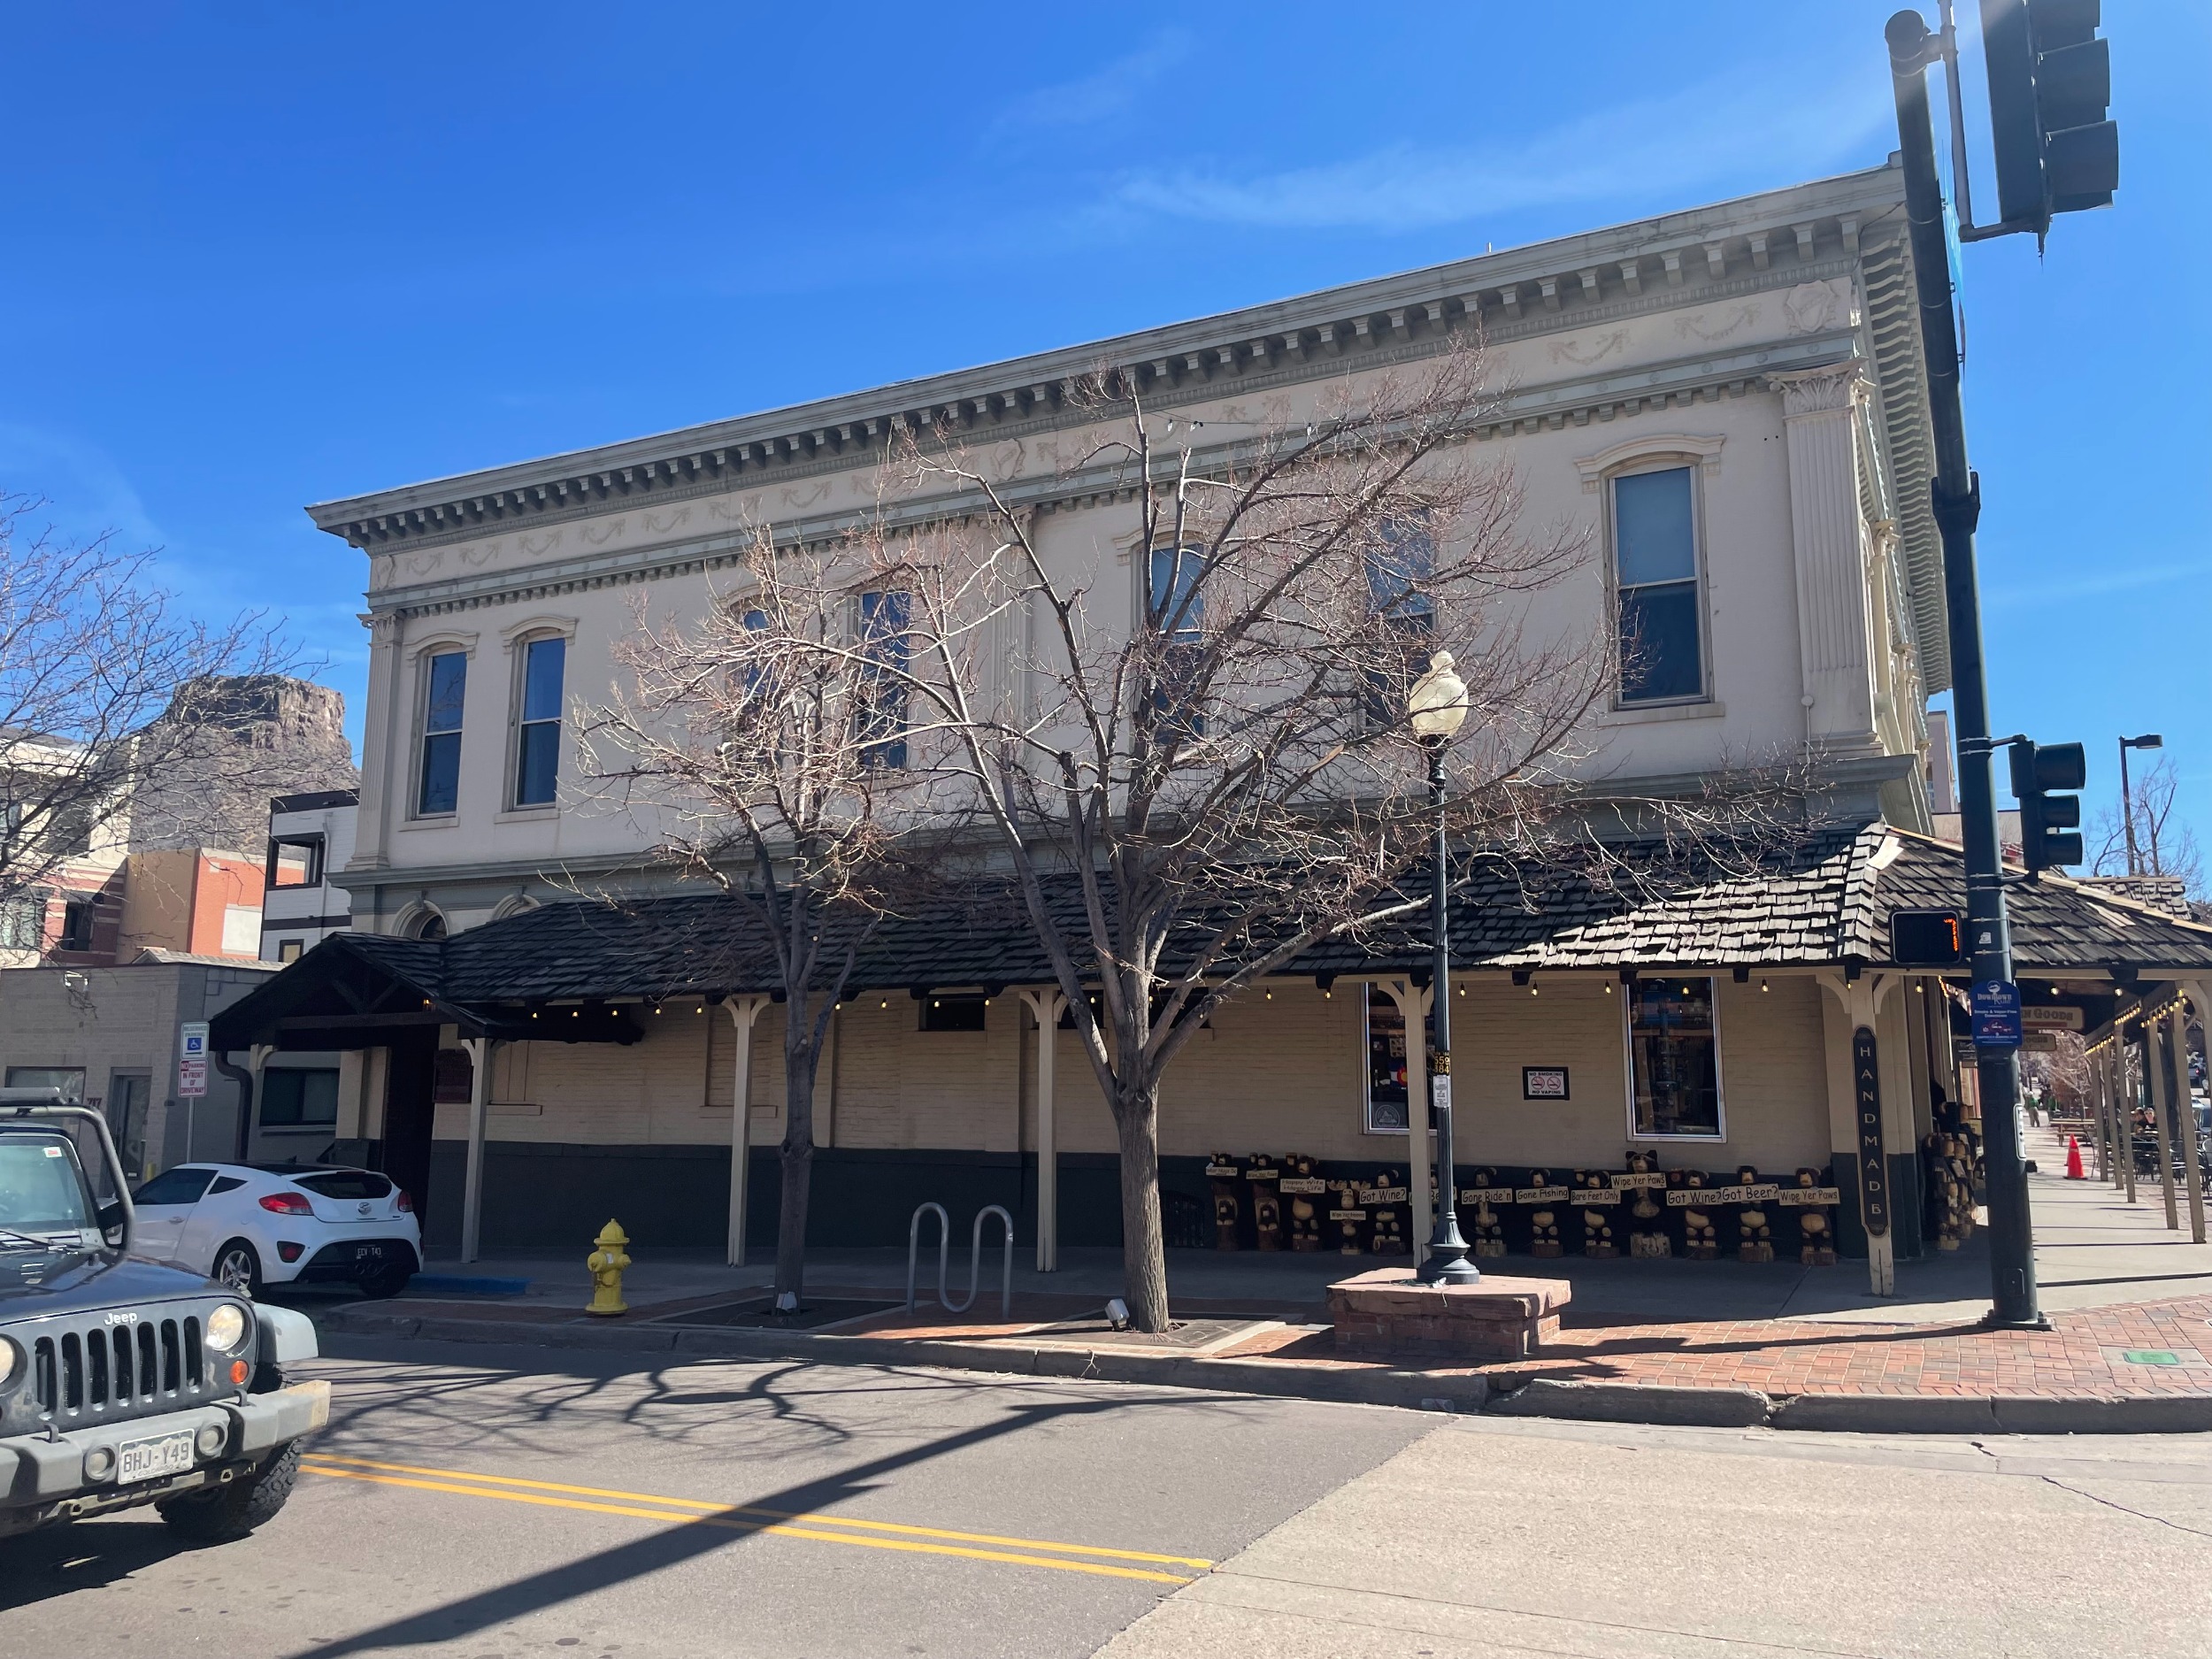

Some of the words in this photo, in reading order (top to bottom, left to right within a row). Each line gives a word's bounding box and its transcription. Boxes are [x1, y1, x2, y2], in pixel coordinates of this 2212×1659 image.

[1859, 1047, 1881, 1215] HANDMADE
[1613, 1178, 1632, 1188] Wipe
[1632, 1176, 1646, 1186] Yer
[1647, 1175, 1665, 1186] Paws
[1360, 1191, 1375, 1202] Got
[1378, 1189, 1405, 1202] Wine?
[1463, 1193, 1482, 1204] Gone
[1517, 1192, 1537, 1201] Gone
[1539, 1188, 1568, 1199] Fishing
[1571, 1192, 1586, 1201] Bare
[1588, 1192, 1602, 1201] Feet
[1668, 1192, 1685, 1204] Got
[1689, 1192, 1721, 1203] Wine?
[1722, 1188, 1740, 1202] Got
[1746, 1186, 1777, 1200] Beer?
[1779, 1193, 1800, 1203] Wipe
[1801, 1191, 1816, 1201] Yer
[1816, 1190, 1838, 1201] Paws
[104, 1312, 138, 1325] Jeep
